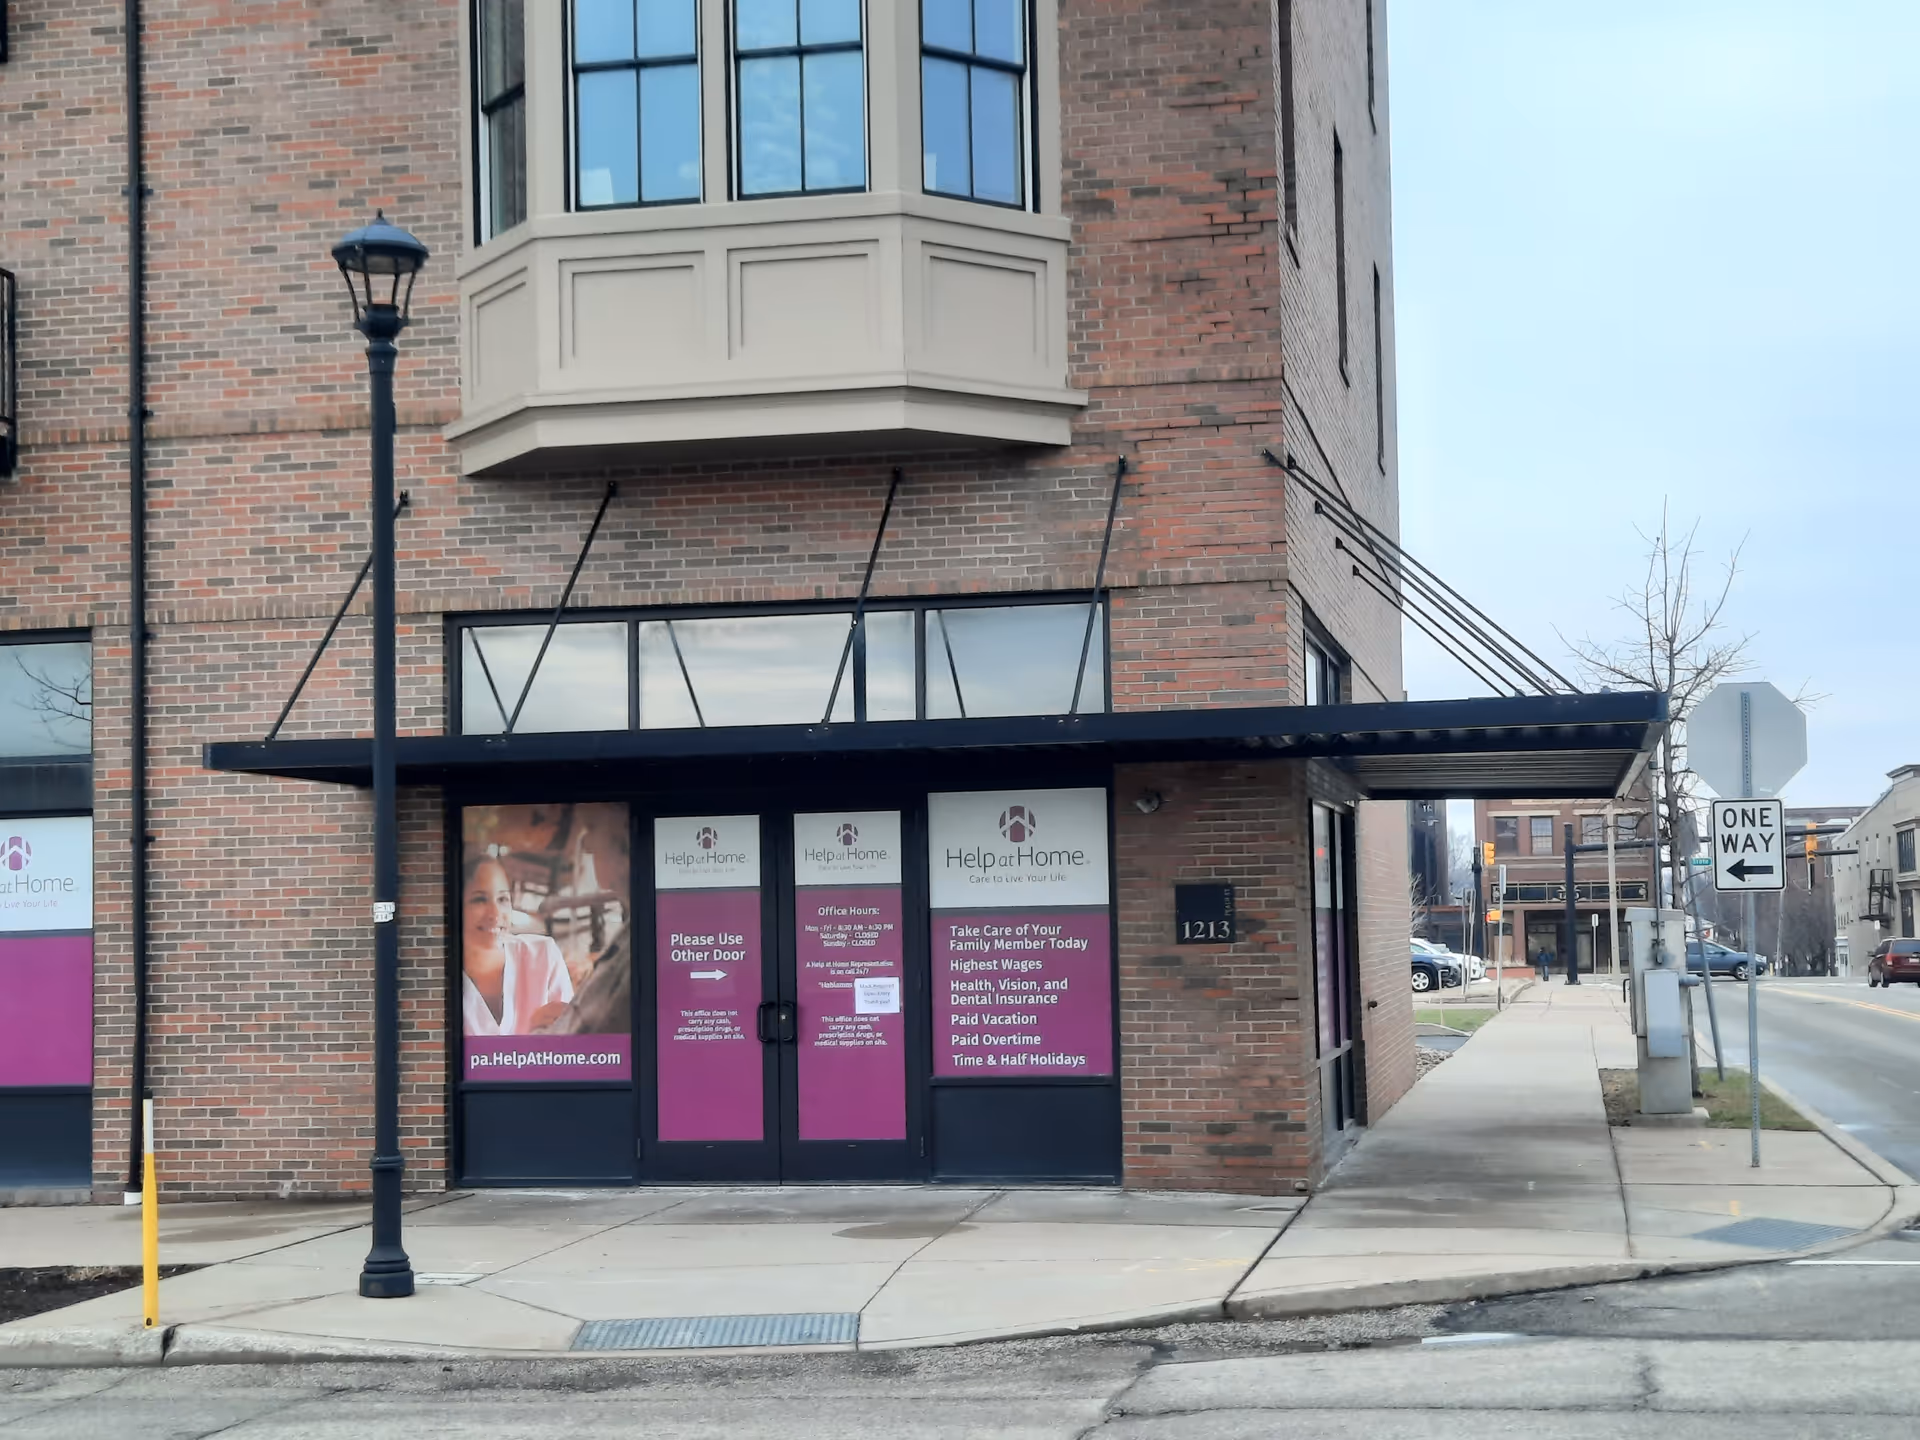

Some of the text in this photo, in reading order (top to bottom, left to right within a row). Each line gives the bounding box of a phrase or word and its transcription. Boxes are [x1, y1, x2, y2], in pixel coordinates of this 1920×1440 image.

[1723, 807, 1773, 828] ONE
[1721, 832, 1775, 853] WAY
[665, 851, 746, 867] Help at Home
[805, 847, 887, 864] Help at Home
[946, 846, 1084, 873] Help at Home
[15, 874, 74, 893] Home
[969, 873, 1067, 883] Care to Live Your Life
[818, 906, 880, 916] Office Hours:
[820, 932, 848, 940] Saturday
[950, 923, 1062, 937] Take Care of Your
[1181, 920, 1230, 940] 1213
[671, 932, 743, 946] Please Use
[949, 936, 1089, 953] Family Member Today
[671, 949, 746, 962] Other Door
[950, 958, 1043, 973] Highest Wages
[950, 978, 1068, 992] Health, Vision, and
[950, 993, 1058, 1005] Dental Insurance
[951, 1012, 1038, 1025] Paid Vacation
[951, 1033, 1041, 1046] Paid Overtime
[470, 1051, 621, 1069] pa.HelpAtHome.com
[952, 1053, 1086, 1067] Time & Half Holidays
